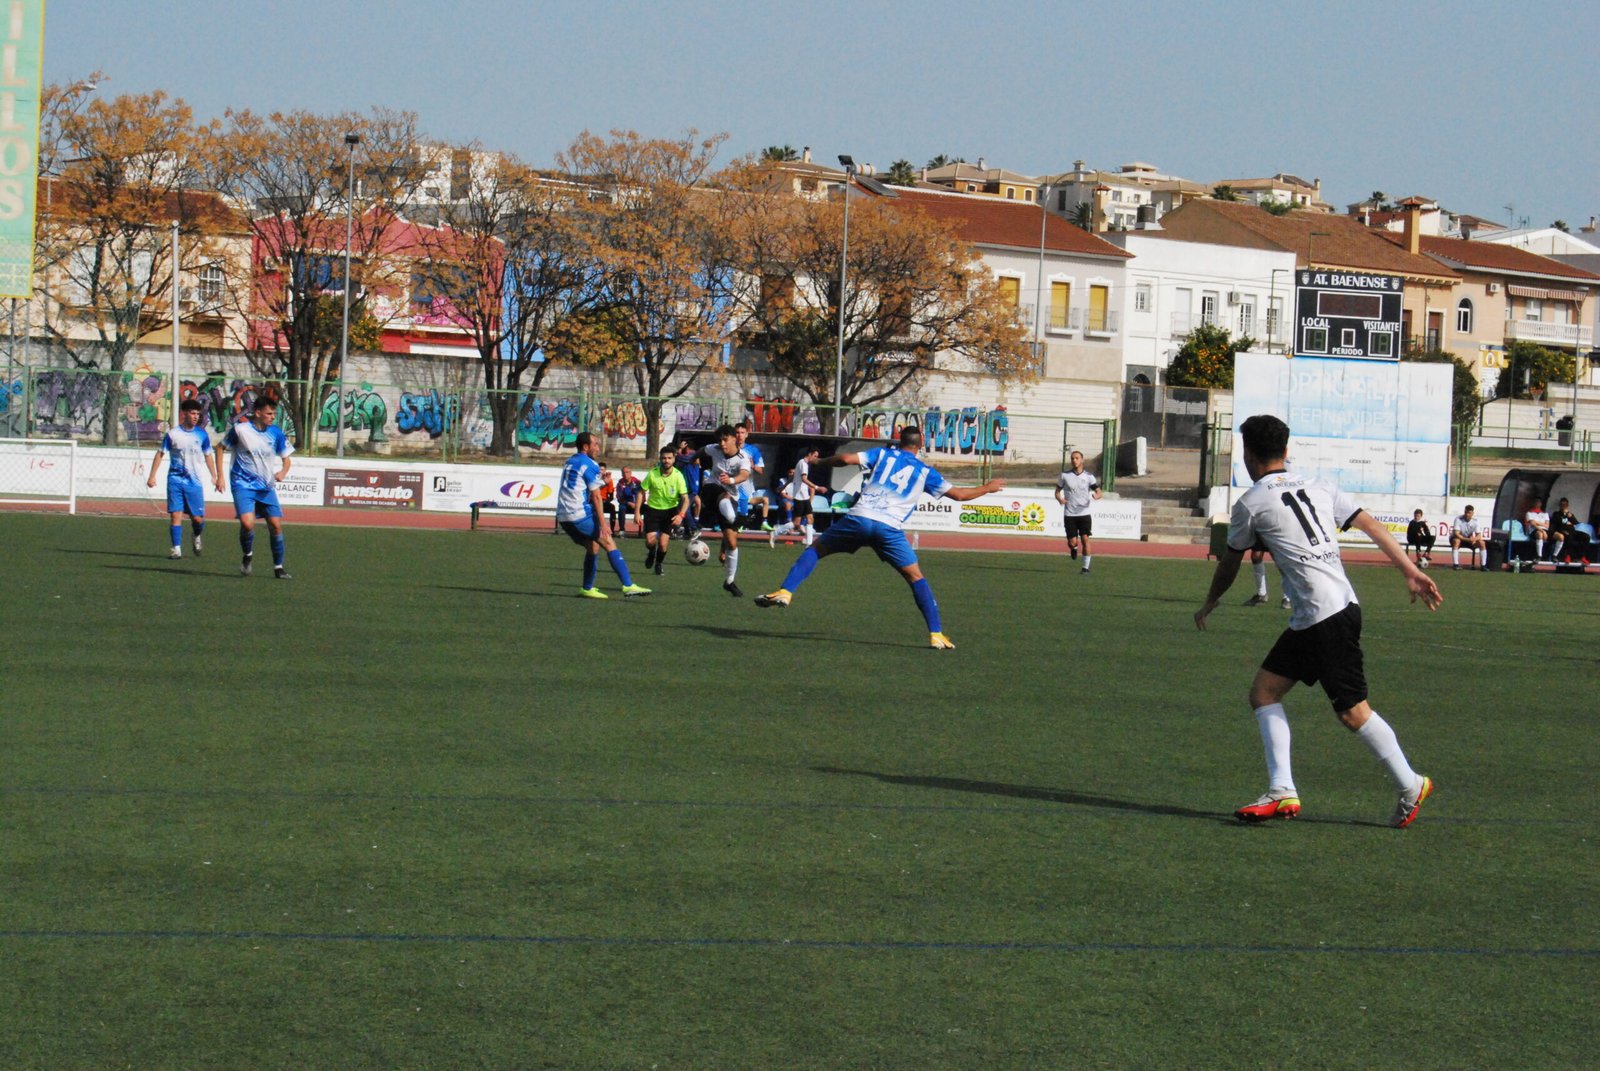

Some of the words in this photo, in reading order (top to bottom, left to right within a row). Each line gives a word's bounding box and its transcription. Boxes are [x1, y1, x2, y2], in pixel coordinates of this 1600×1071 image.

[1313, 273, 1328, 286] AT.
[1331, 274, 1388, 289] BAENENSE
[1301, 317, 1331, 328] LOCAL
[1363, 320, 1400, 332] VISITANTE
[1332, 347, 1364, 356] PERIODO
[924, 406, 1009, 456] MAGIC
[878, 456, 915, 495] 14
[275, 484, 318, 493] JALANCE
[915, 501, 952, 513] abéu
[960, 512, 1020, 525] CONTRERAS
[1281, 488, 1331, 547] 11
